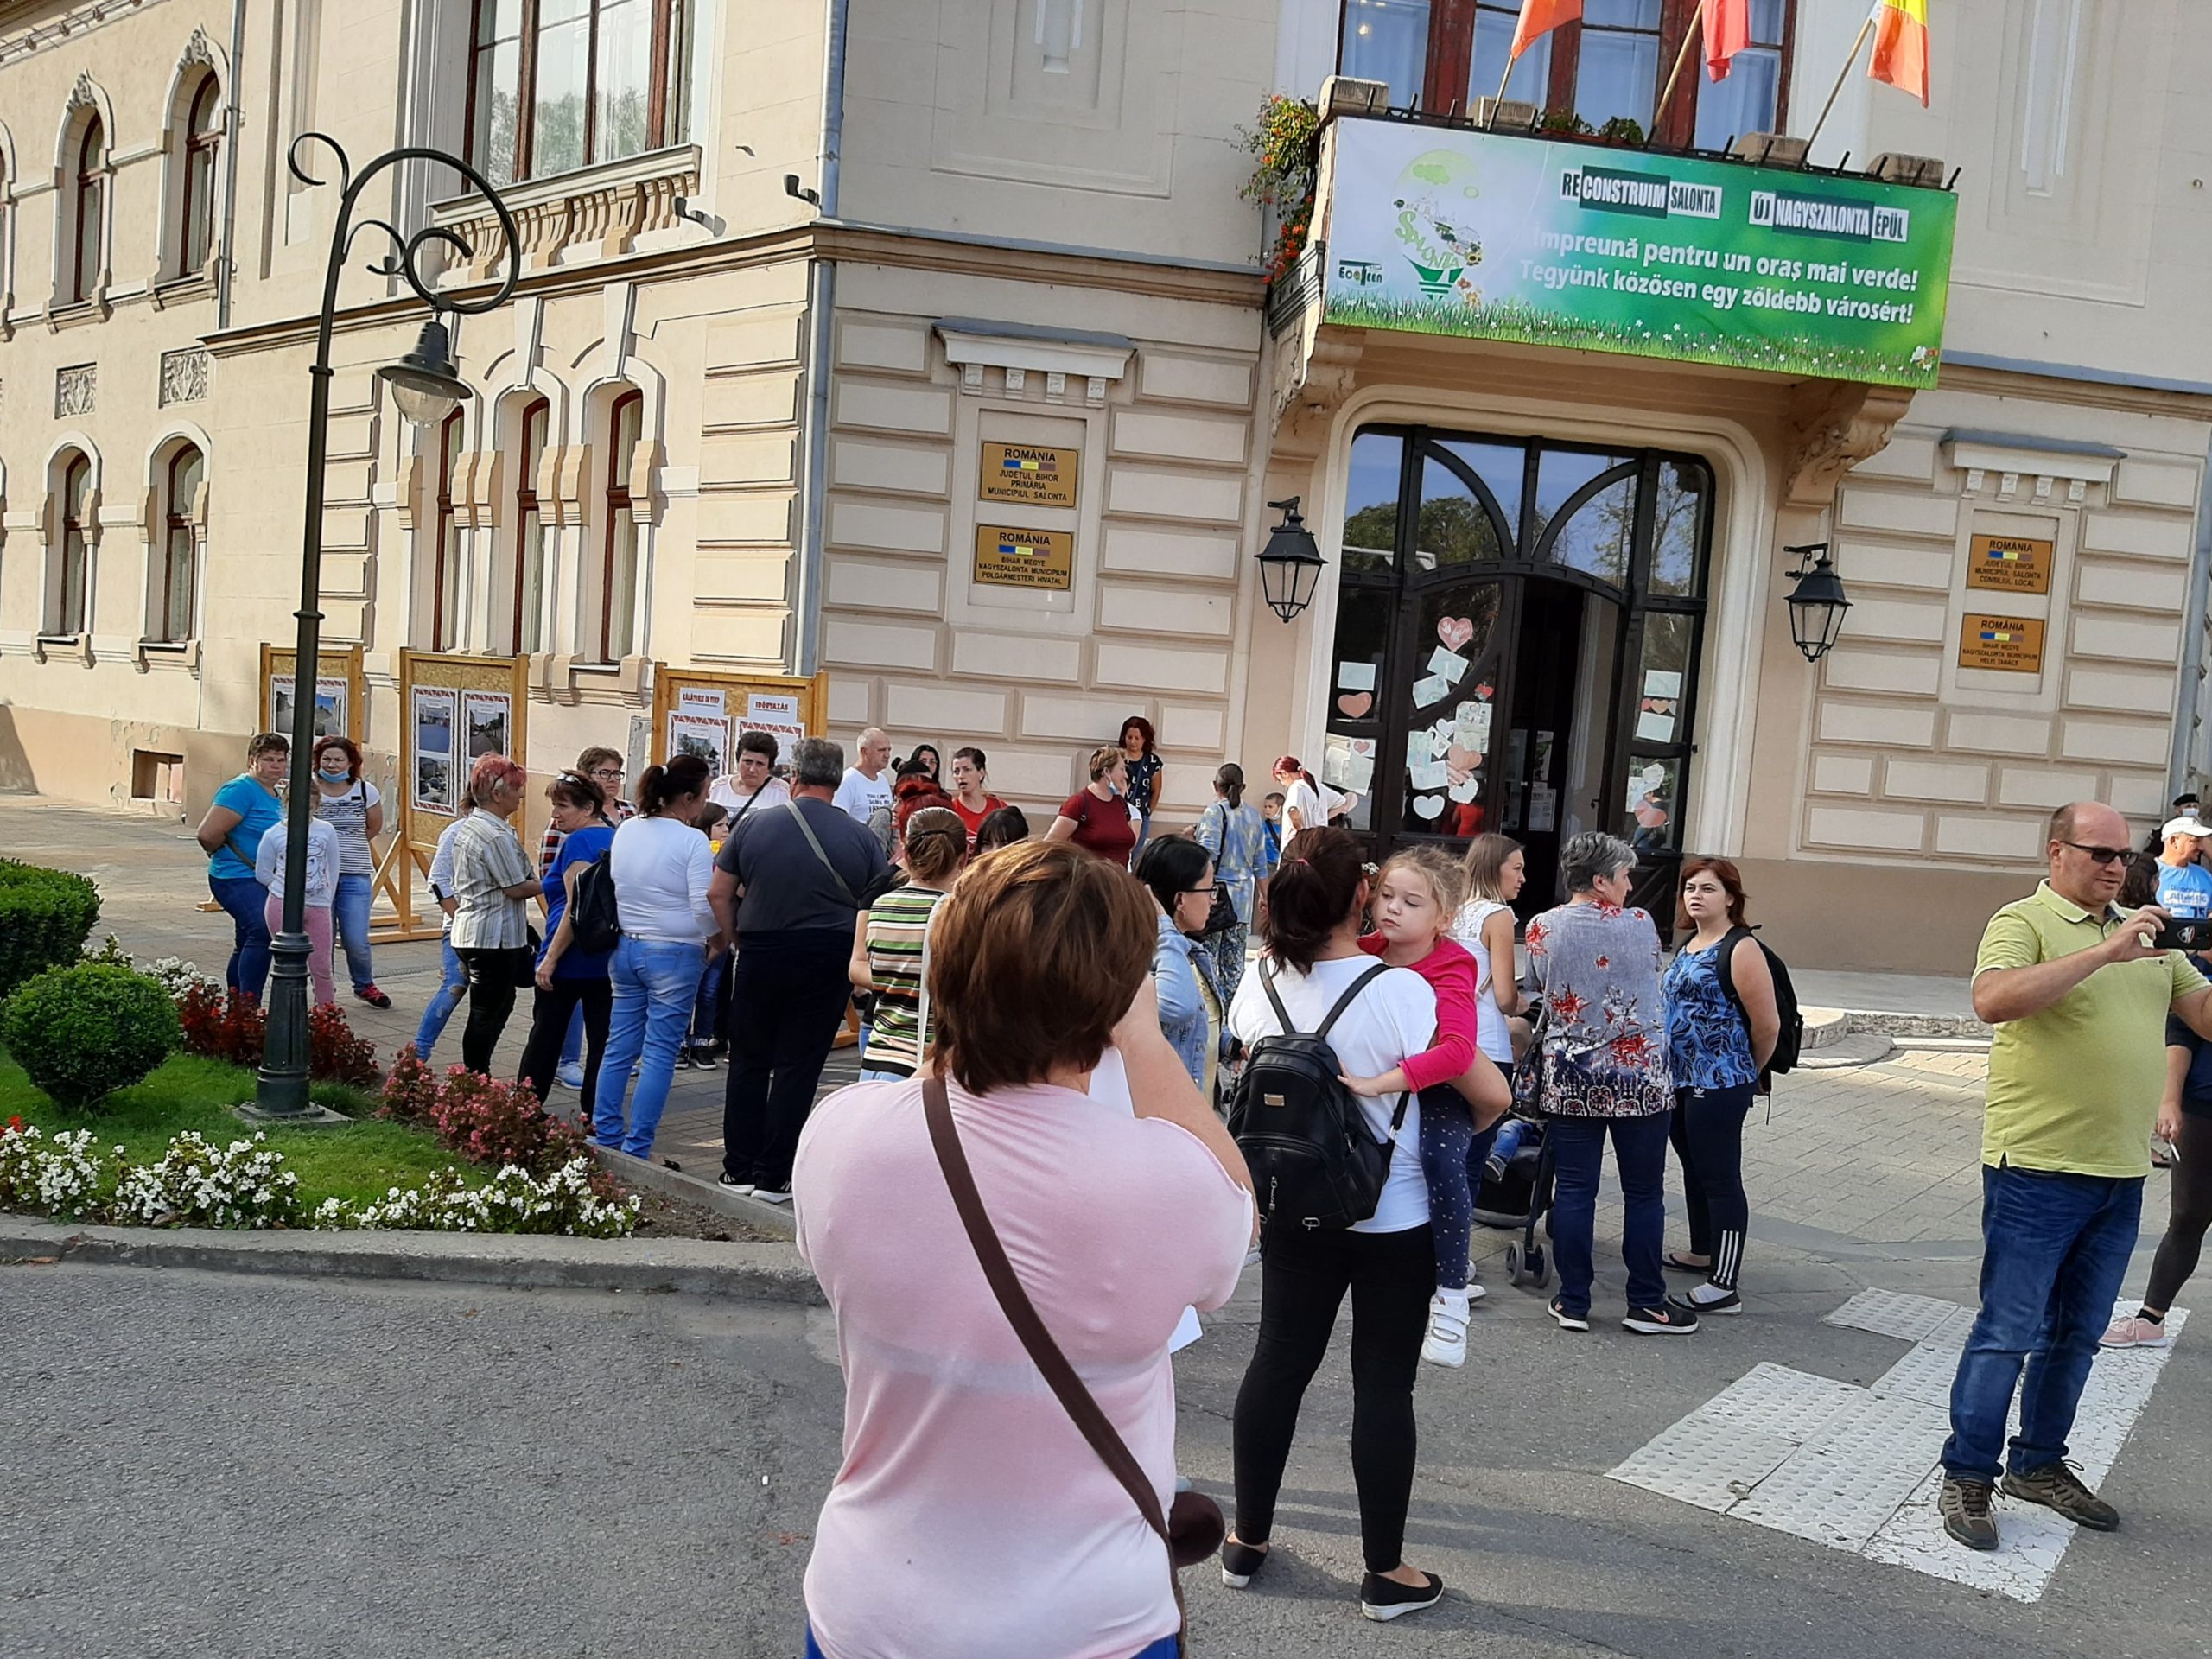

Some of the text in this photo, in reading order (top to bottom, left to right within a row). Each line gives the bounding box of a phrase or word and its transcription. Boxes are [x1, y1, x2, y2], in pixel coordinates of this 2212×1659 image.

[1670, 186, 1716, 213] SALONTA
[1753, 197, 1904, 238] ÚJ NAGYSZALONTA ÉPÜL
[1534, 224, 1919, 292] Împreună pentru un oraș mai verde!
[1521, 260, 1915, 325] Tegyünk közösen egy zöldebb városért!
[1004, 448, 1056, 461] ROMÂNIA
[1036, 474, 1058, 482] BIHOR
[988, 487, 1067, 501] MUNICIPIUL SALONTA
[999, 532, 1051, 545] ROMÂNIA
[1989, 540, 2033, 552] ROMÂNIA
[1024, 558, 1046, 567] MEGYE
[978, 563, 1068, 576] NAGYSZALONTA MUNICIPIUM
[982, 571, 1063, 585] POLGÁRMESTERI HIVATAL
[1980, 620, 2025, 632] ROMÂNIA
